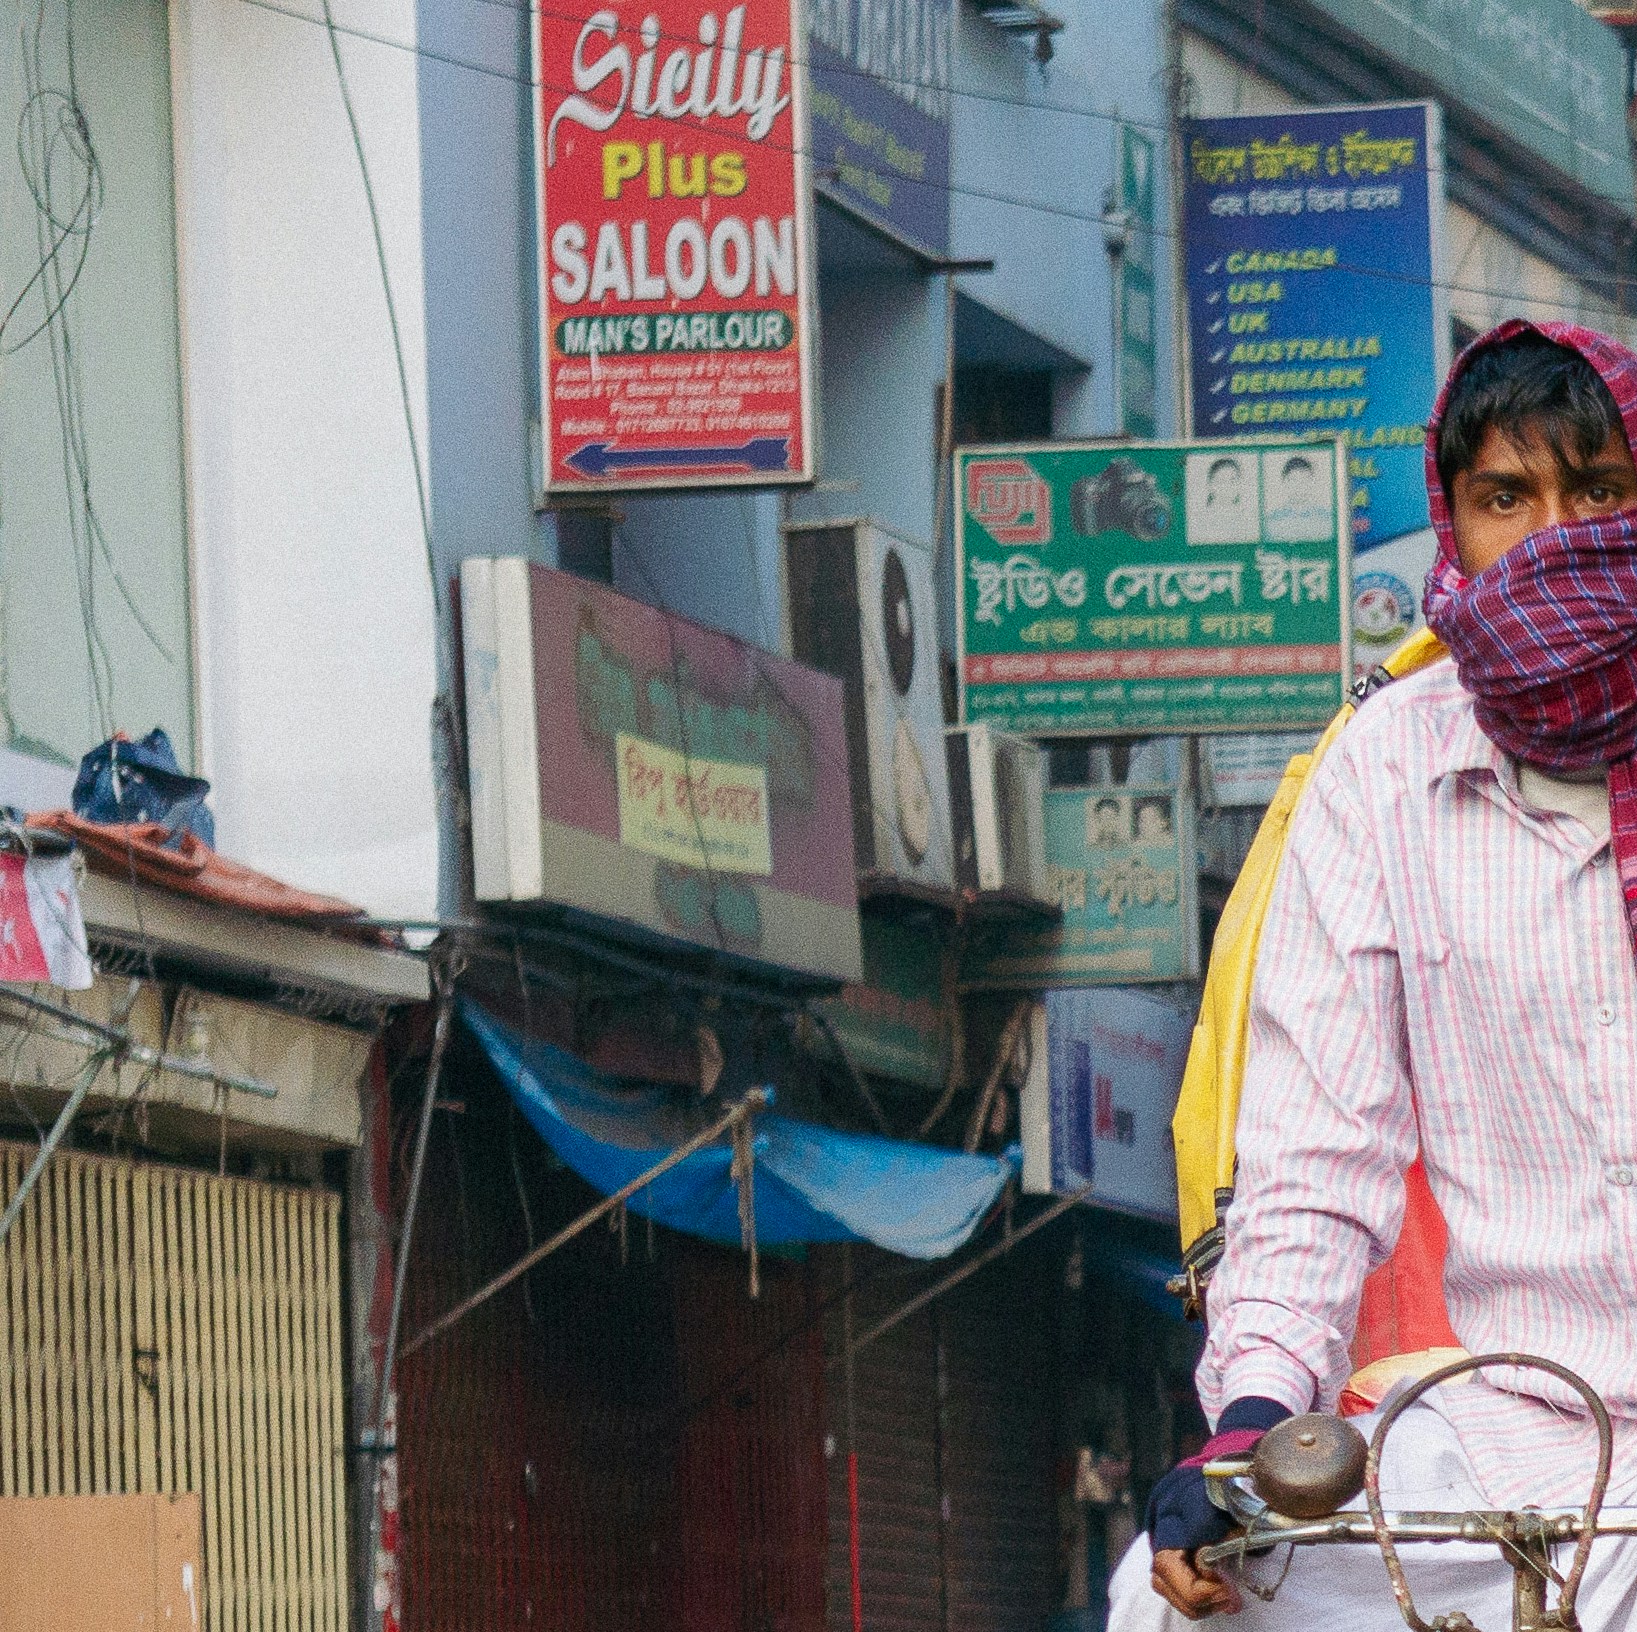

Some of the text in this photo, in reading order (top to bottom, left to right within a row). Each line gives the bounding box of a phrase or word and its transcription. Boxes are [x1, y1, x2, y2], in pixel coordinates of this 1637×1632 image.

[547, 5, 792, 168] Sicily
[602, 141, 749, 199] Plus
[551, 216, 797, 304] SALOON
[1226, 247, 1338, 274] CANADA
[1227, 281, 1284, 305] USA
[563, 314, 785, 354] MAN'S PARLOUR
[1227, 310, 1270, 335] UK
[1229, 336, 1383, 364] AUSTRALIA
[1231, 367, 1366, 394] DENMARK
[1232, 397, 1368, 424] GERMANY
[1105, 561, 1245, 610] সেভেন
